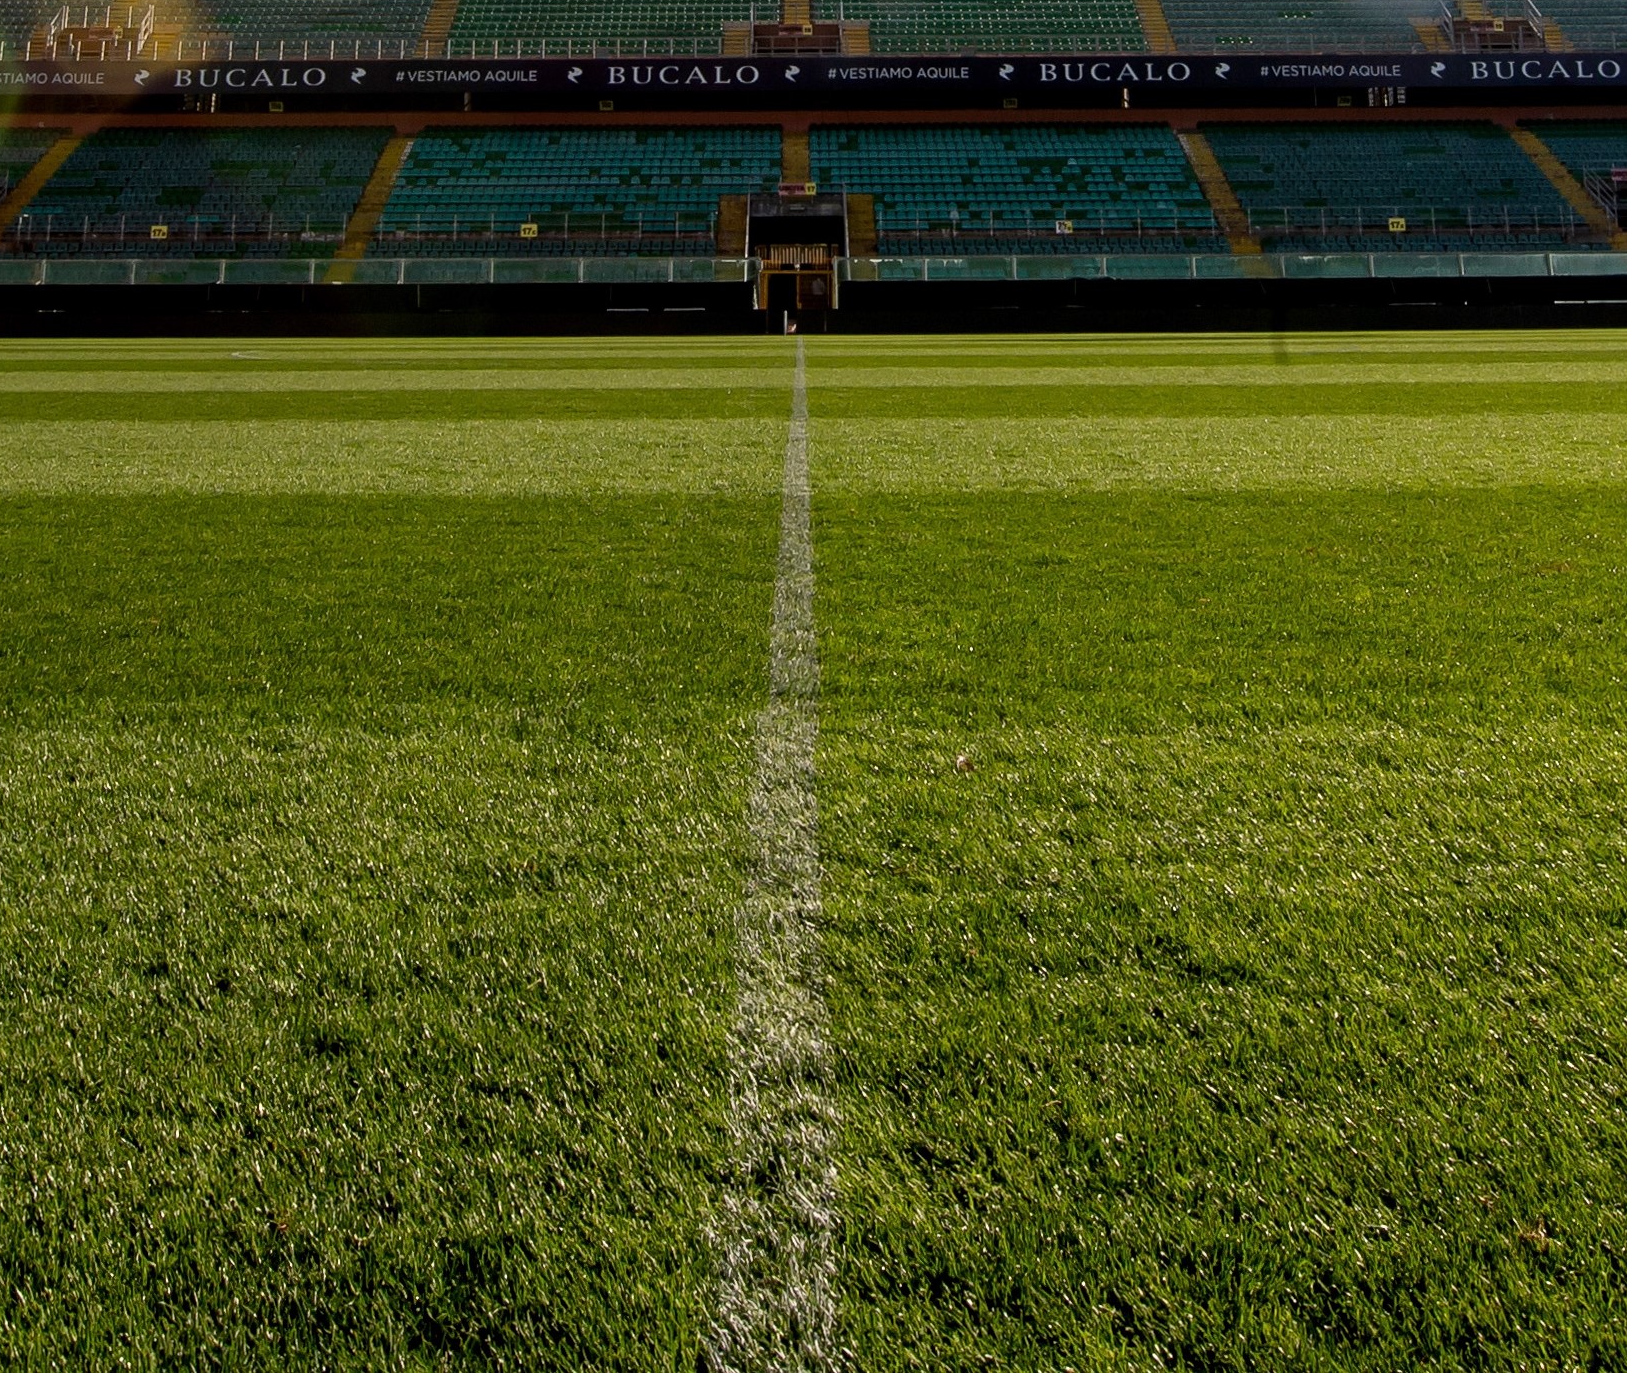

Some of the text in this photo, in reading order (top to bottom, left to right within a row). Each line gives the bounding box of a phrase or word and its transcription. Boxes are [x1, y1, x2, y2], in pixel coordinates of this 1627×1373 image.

[52, 73, 105, 85] AQUILE
[174, 68, 326, 87] BUCALO
[485, 70, 538, 83] AQUILE
[608, 65, 760, 84] BUCALO
[917, 67, 970, 80] AQUILE
[1040, 62, 1191, 81] BUCALO
[1349, 64, 1402, 77] AQUILE
[1471, 60, 1621, 79] BUCALO
